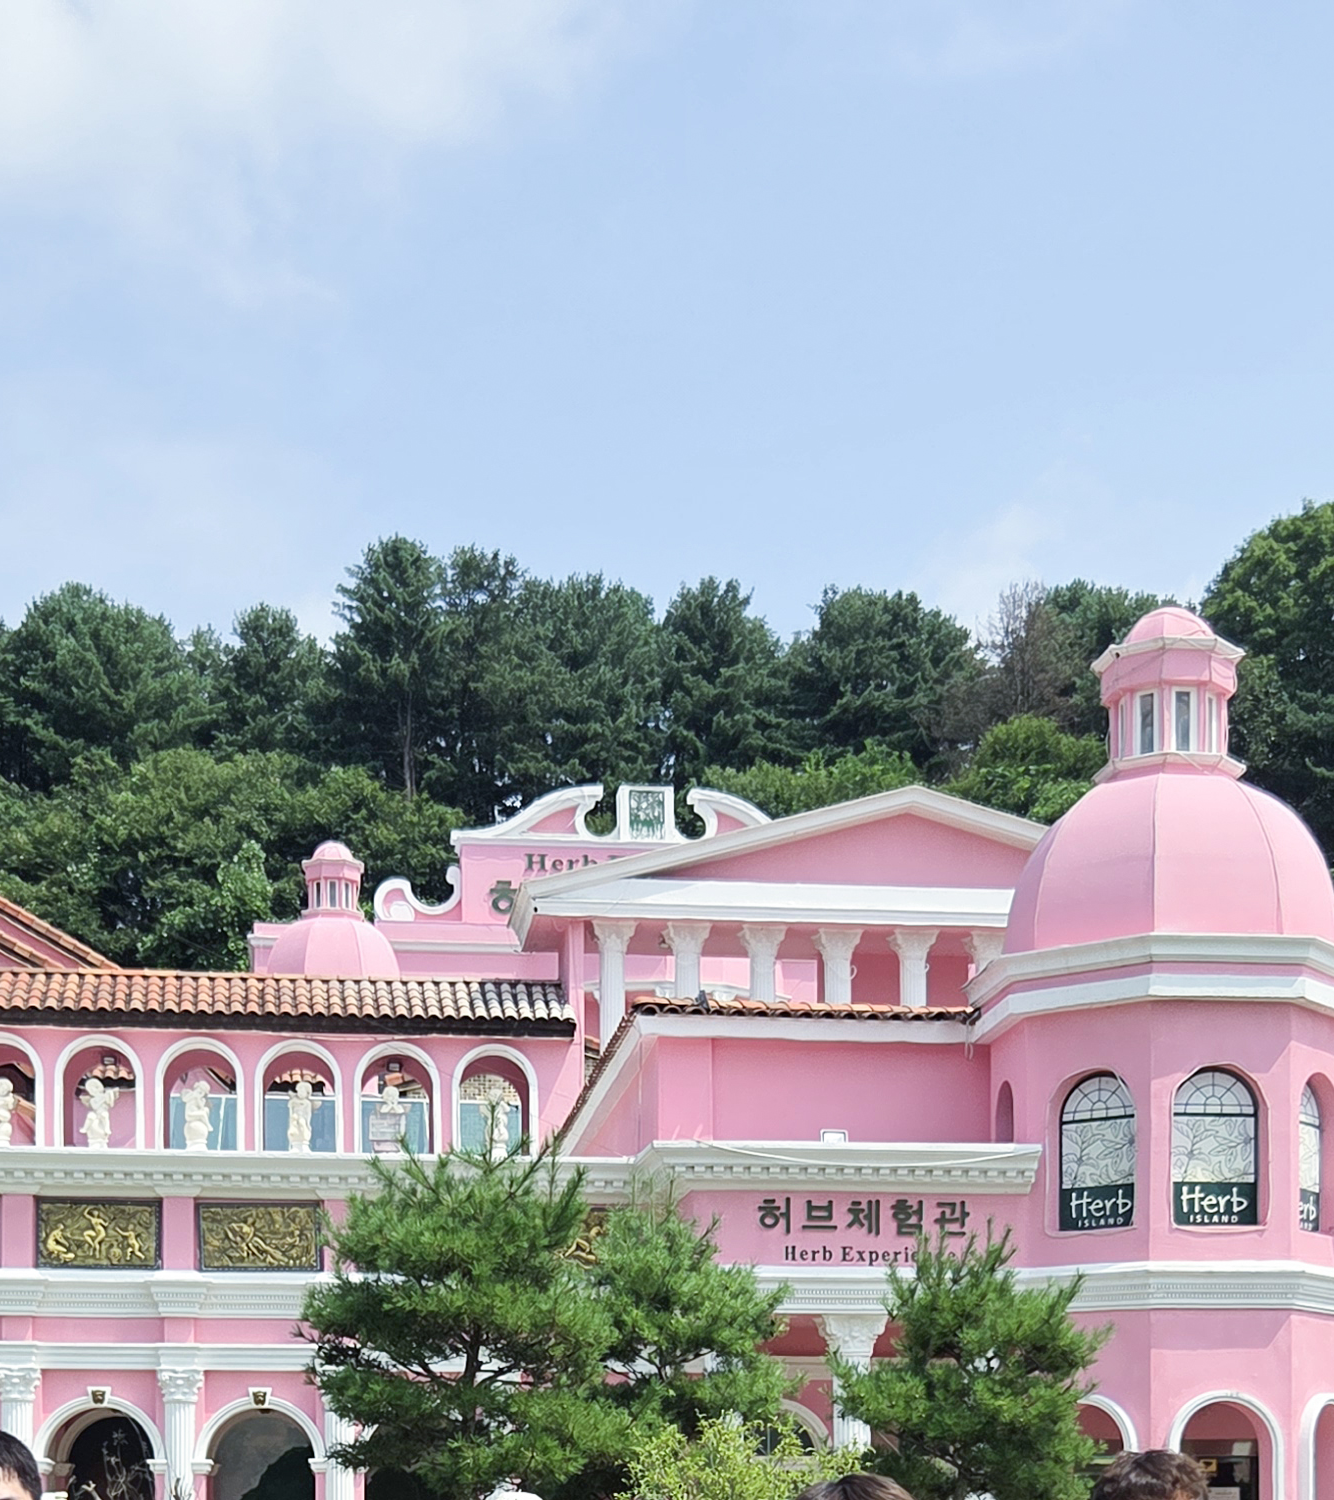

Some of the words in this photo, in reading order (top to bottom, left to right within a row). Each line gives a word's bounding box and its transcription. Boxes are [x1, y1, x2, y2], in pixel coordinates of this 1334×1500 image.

[524, 853, 598, 872] Herb
[1069, 1189, 1133, 1219] Herb
[1180, 1185, 1249, 1214] Herb
[1299, 1195, 1317, 1221] erb
[757, 1196, 971, 1238] 허브체험관
[1077, 1216, 1124, 1228] ISLAND
[1189, 1213, 1239, 1224] ISLAND
[784, 1245, 833, 1263] Herb
